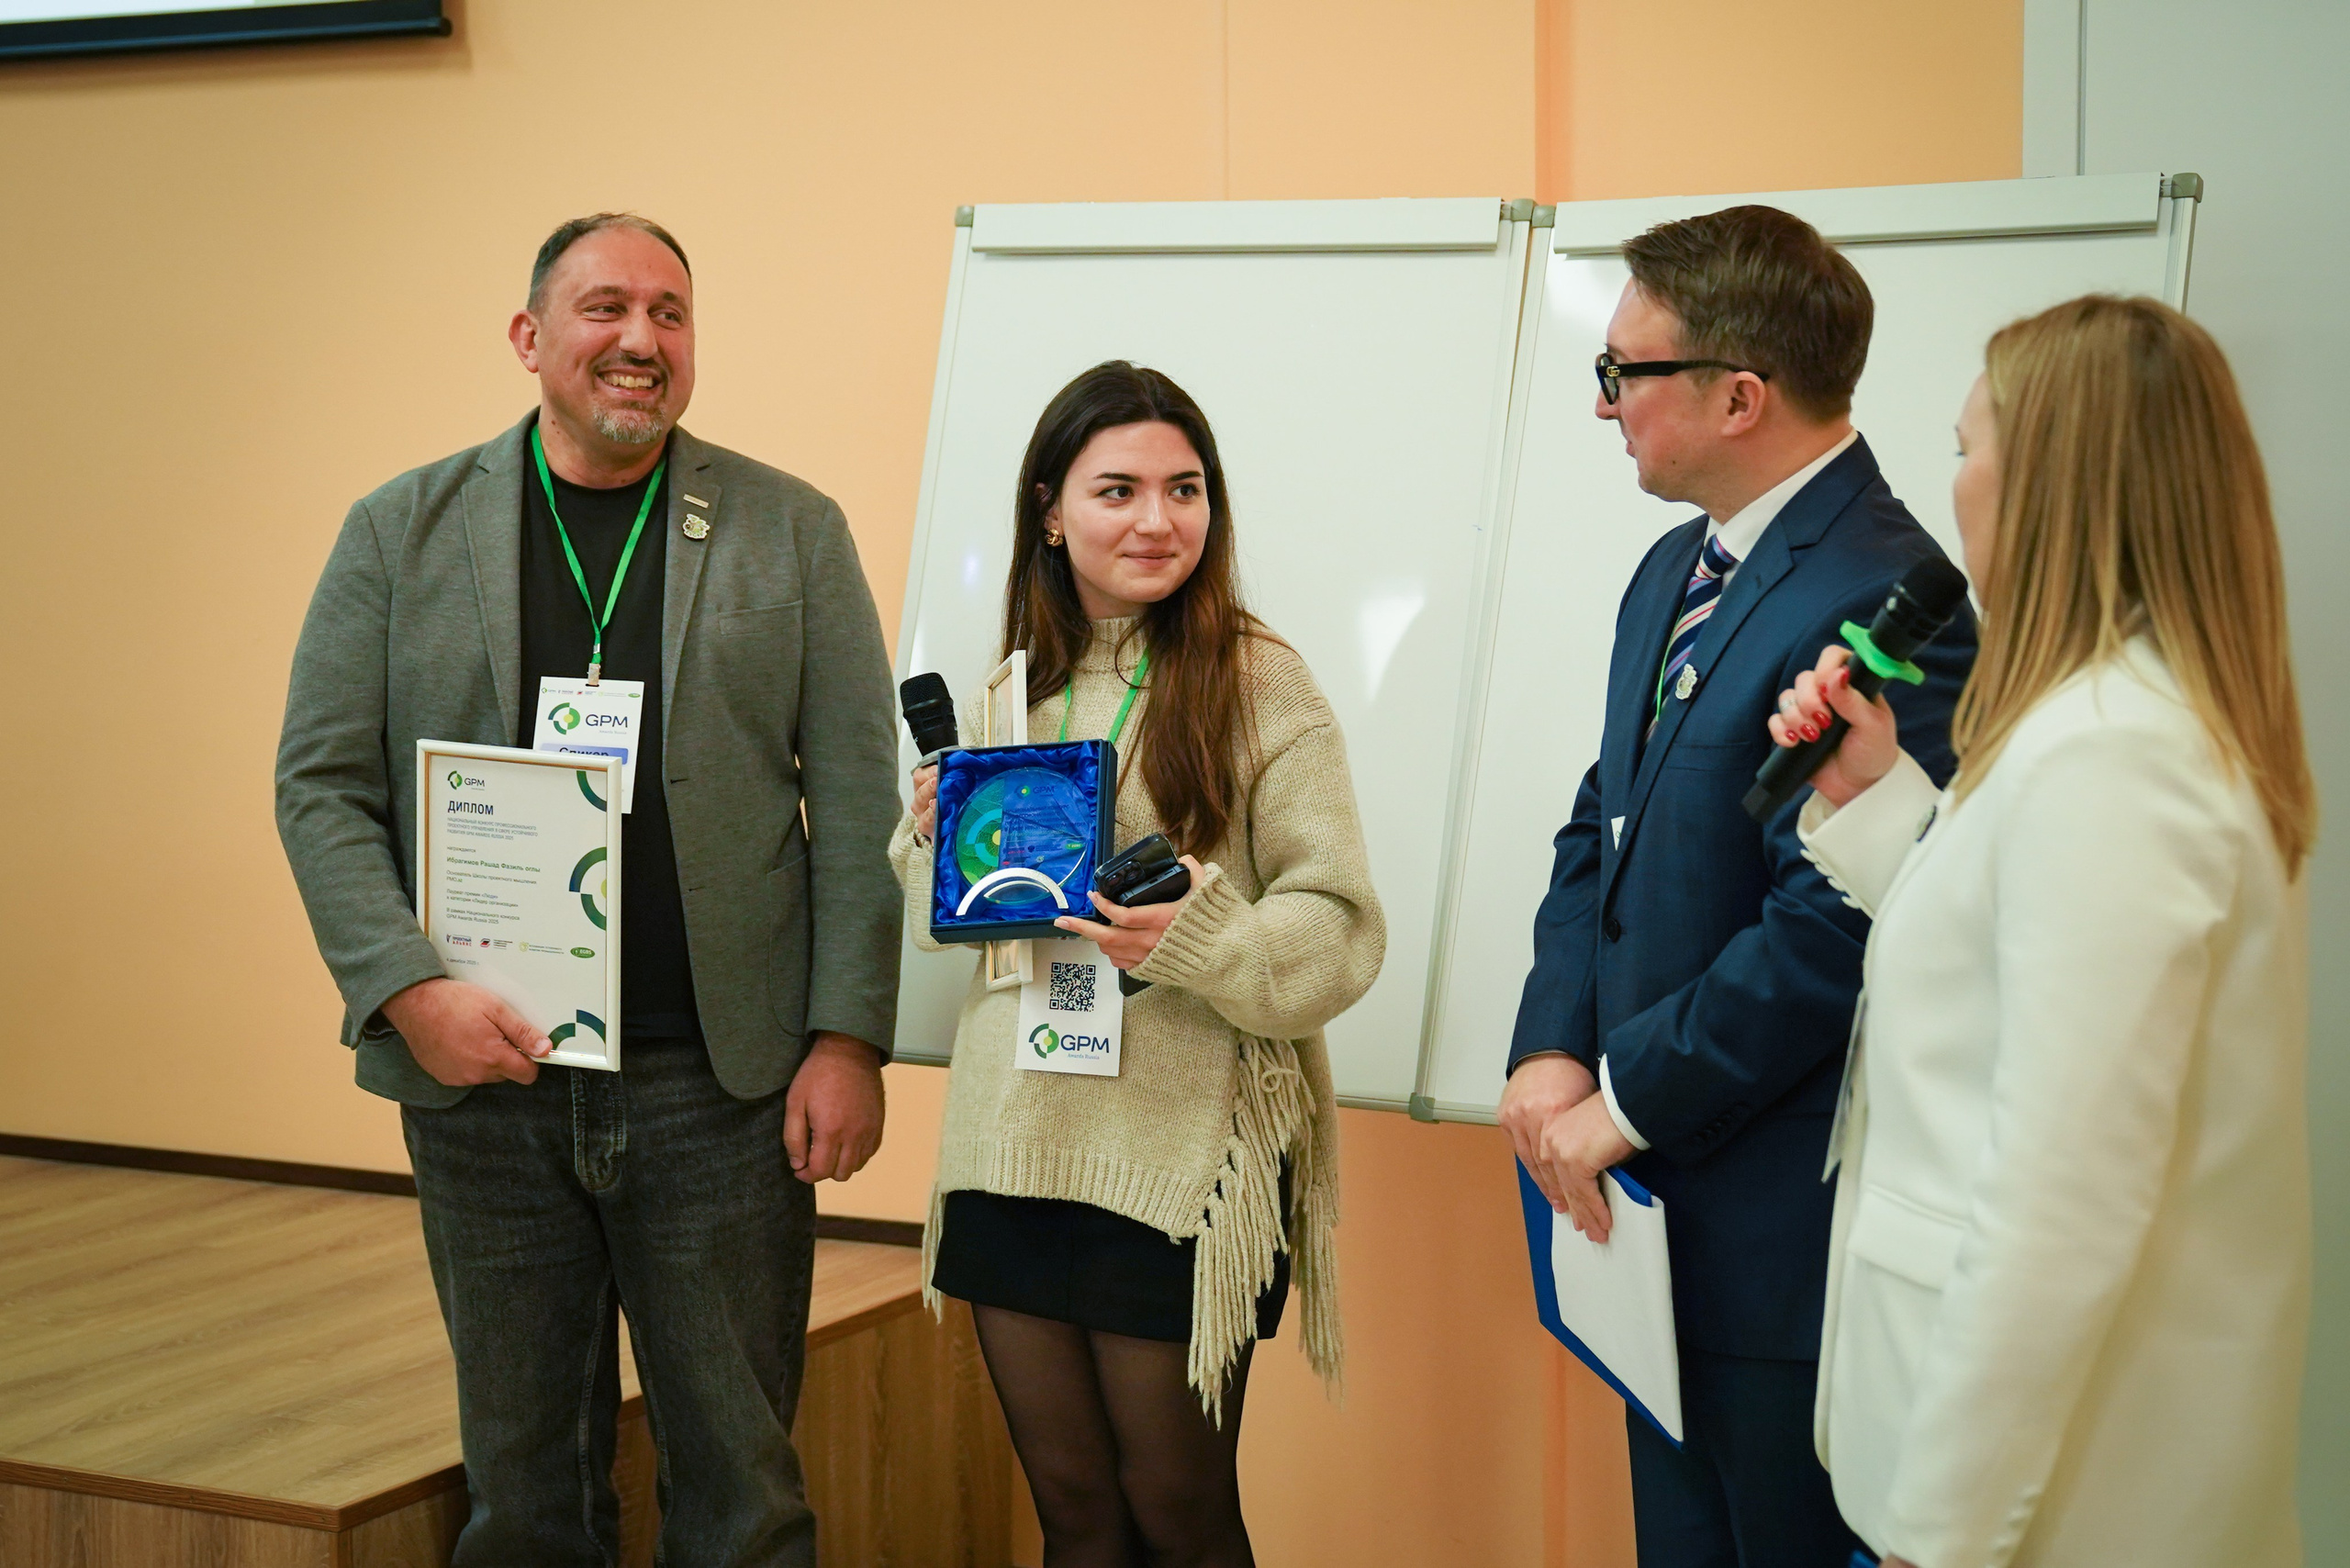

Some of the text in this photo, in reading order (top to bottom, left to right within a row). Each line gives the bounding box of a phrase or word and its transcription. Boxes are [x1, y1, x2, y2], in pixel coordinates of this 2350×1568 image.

[586, 714, 628, 728] GPM
[464, 778, 485, 787] GPM
[1033, 786, 1056, 794] GPM
[448, 801, 494, 815] ДИПЛОМ
[447, 857, 479, 866] Ибрагимов
[480, 860, 499, 868] Рашад
[500, 863, 524, 871] Фазиль
[1060, 1035, 1110, 1053] GPM
